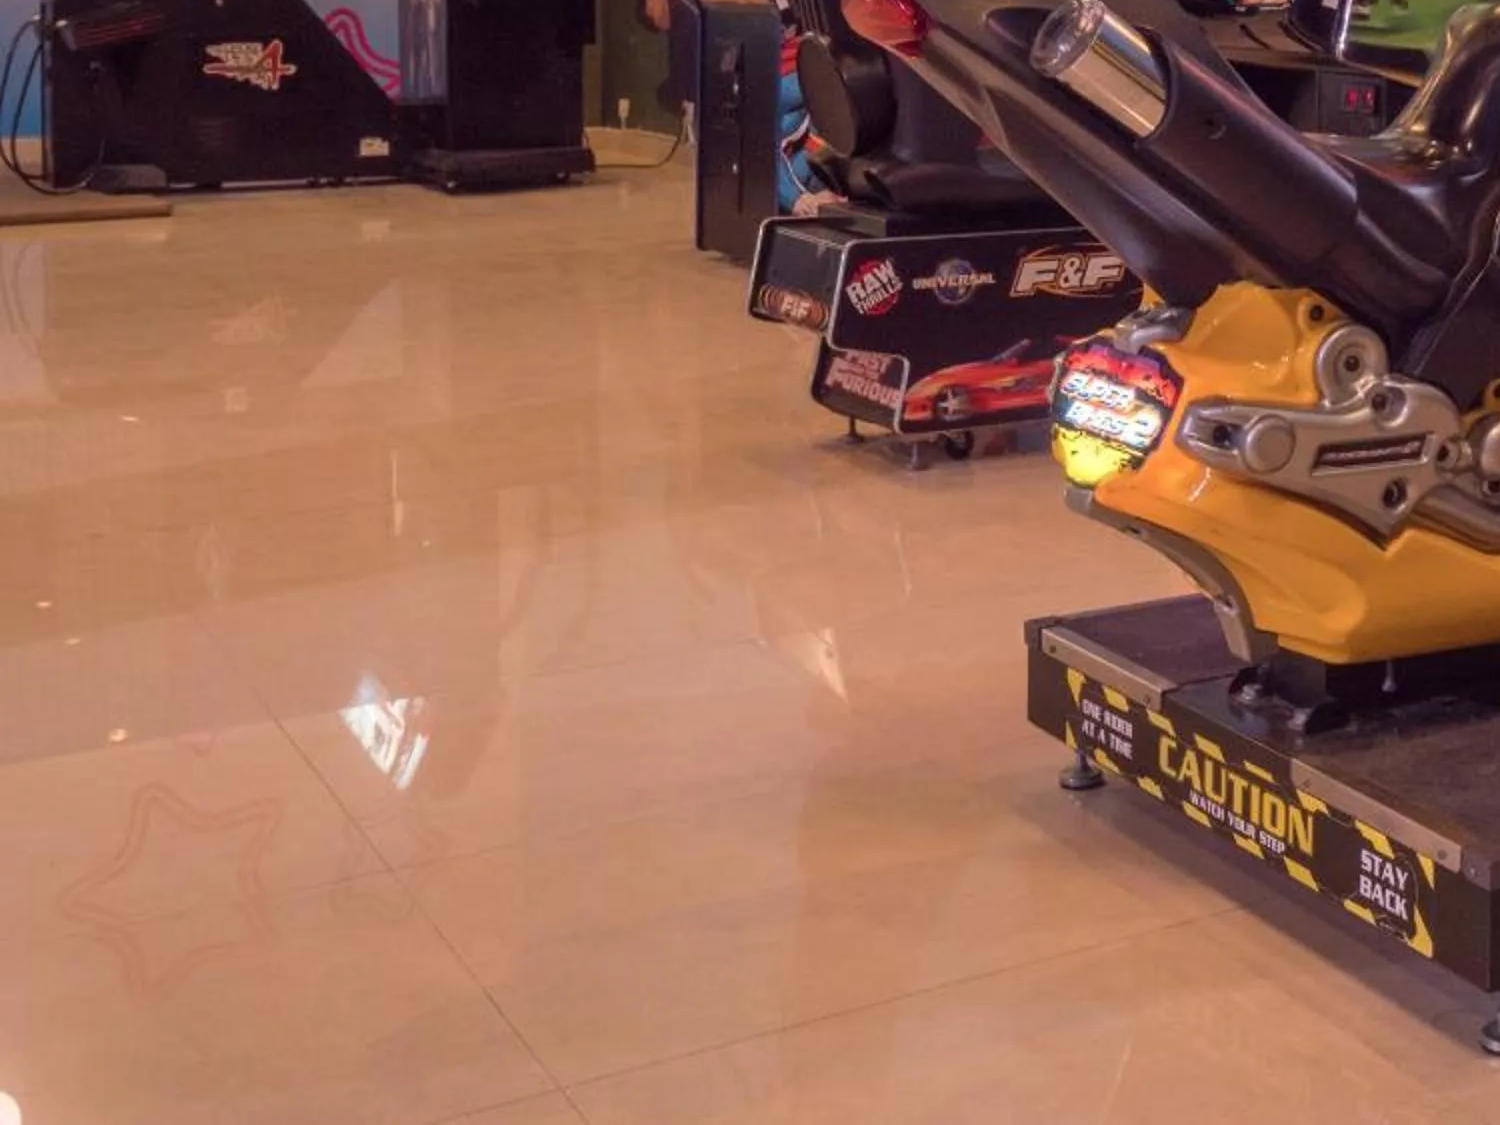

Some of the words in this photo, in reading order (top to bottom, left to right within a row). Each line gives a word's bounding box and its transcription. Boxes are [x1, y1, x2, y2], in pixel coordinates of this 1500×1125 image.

[845, 258, 897, 305] RAW
[911, 271, 997, 291] UNIVERSAL
[1011, 253, 1126, 298] F&F
[824, 356, 901, 410] FURIOUS
[1060, 370, 1135, 413] SUPER
[1122, 405, 1163, 449] 2
[1081, 698, 1102, 722] ONE
[1081, 718, 1095, 739] AT
[1158, 734, 1315, 858] CAUTION
[1188, 787, 1226, 822] WATCH
[1227, 810, 1257, 840] YOUR
[1258, 829, 1286, 856] STEP
[1360, 848, 1409, 892] STAY
[1359, 873, 1410, 923] BACK
